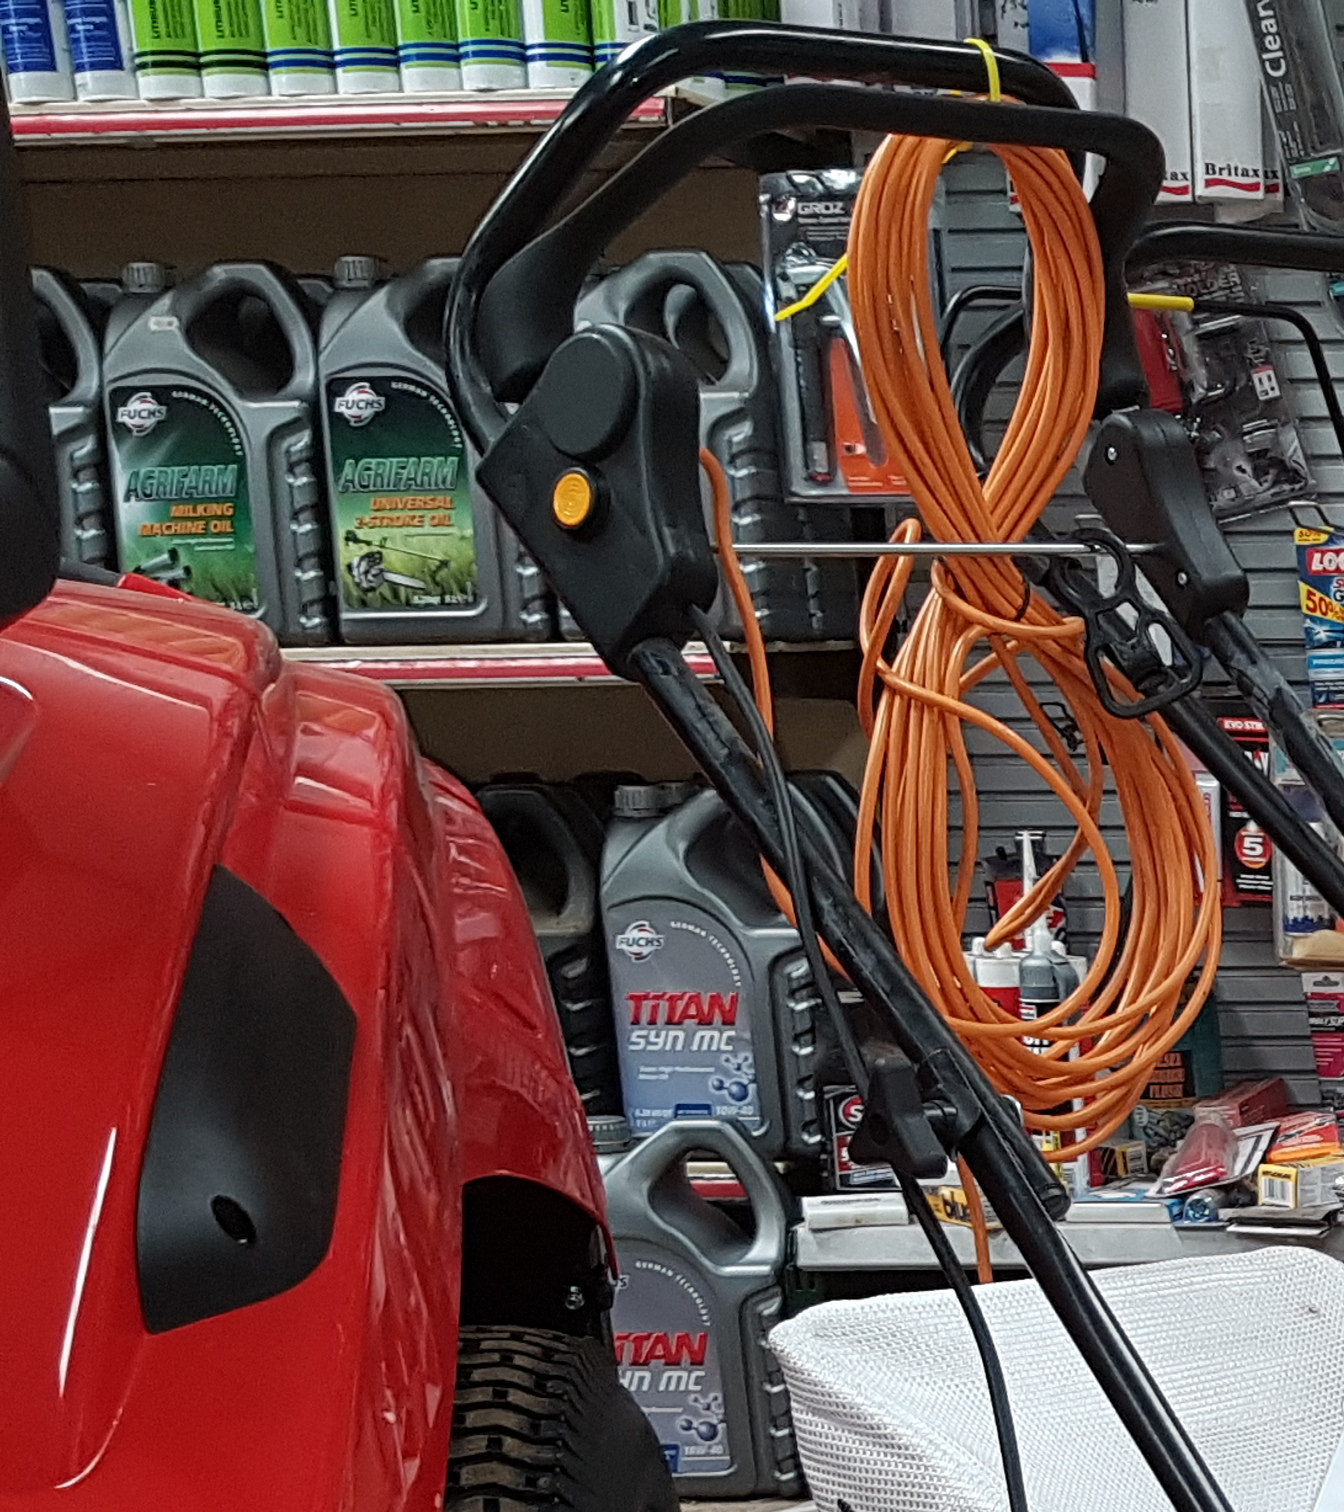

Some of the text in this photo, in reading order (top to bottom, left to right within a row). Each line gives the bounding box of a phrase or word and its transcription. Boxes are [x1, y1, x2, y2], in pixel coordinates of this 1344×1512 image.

[1204, 163, 1260, 178] Britax
[798, 202, 845, 214] GROZ
[338, 398, 383, 410] FUCHS
[120, 407, 164, 419] FUCHS
[339, 457, 459, 492] AGRIFARM
[124, 465, 238, 502] AGRIFARM
[171, 503, 234, 518] MILKING
[371, 496, 455, 511] UNIVERSAL
[139, 520, 234, 536] MACHINE OIL
[1243, 837, 1264, 856] 5
[619, 935, 663, 947] FUCHS
[627, 991, 739, 1025] TITAN
